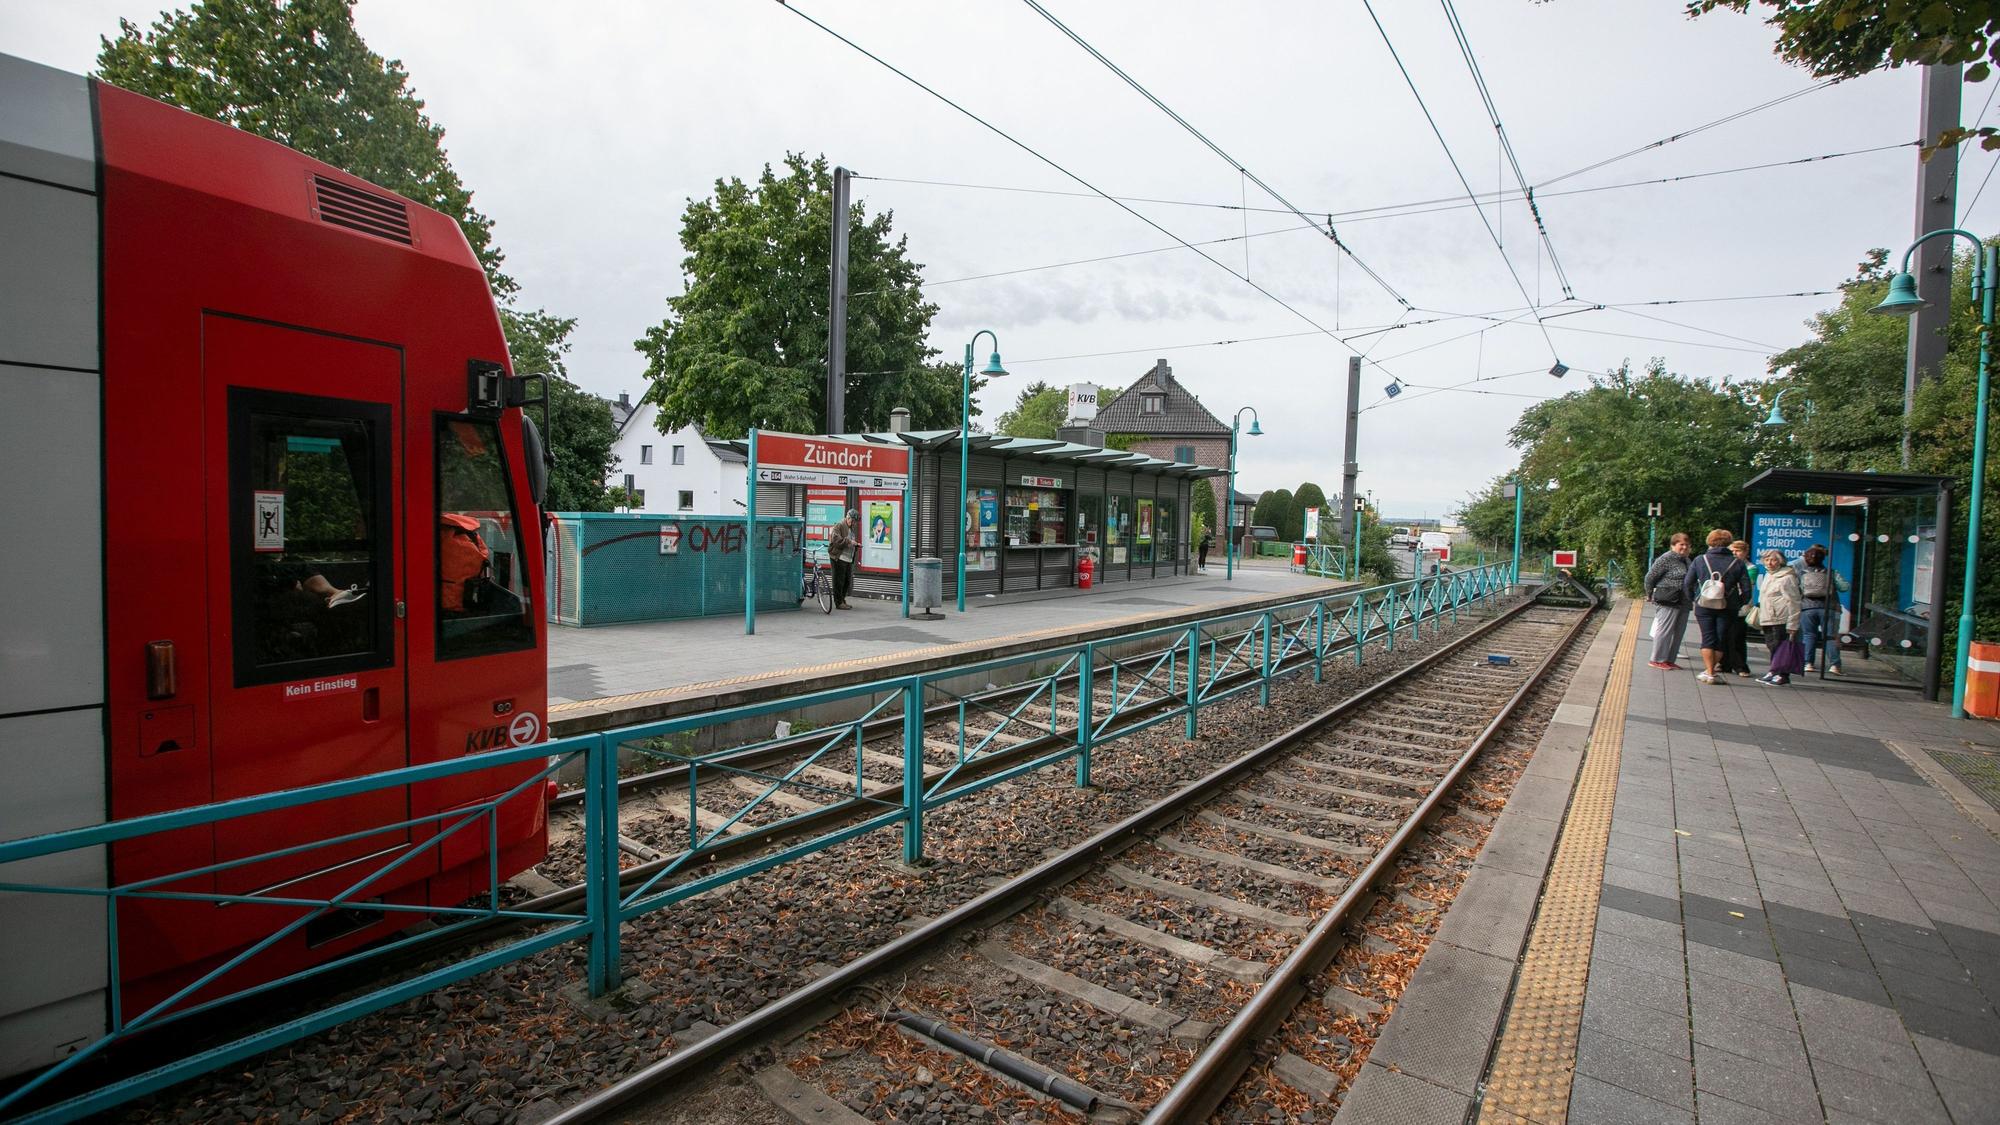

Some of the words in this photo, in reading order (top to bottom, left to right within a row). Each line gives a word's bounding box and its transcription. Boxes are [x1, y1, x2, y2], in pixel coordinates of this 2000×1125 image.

[1077, 394, 1096, 403] KVB
[804, 444, 873, 468] Zündorf
[1354, 498, 1365, 511] H
[1648, 502, 1662, 516] H
[1759, 517, 1793, 527] BUNTER
[1796, 518, 1821, 528] PULLI
[1767, 528, 1813, 538] BADEHOSE
[1767, 537, 1795, 548] BÜRO?
[286, 684, 311, 697] Kein
[314, 678, 357, 692] Einstieg
[465, 726, 508, 754] KVB
